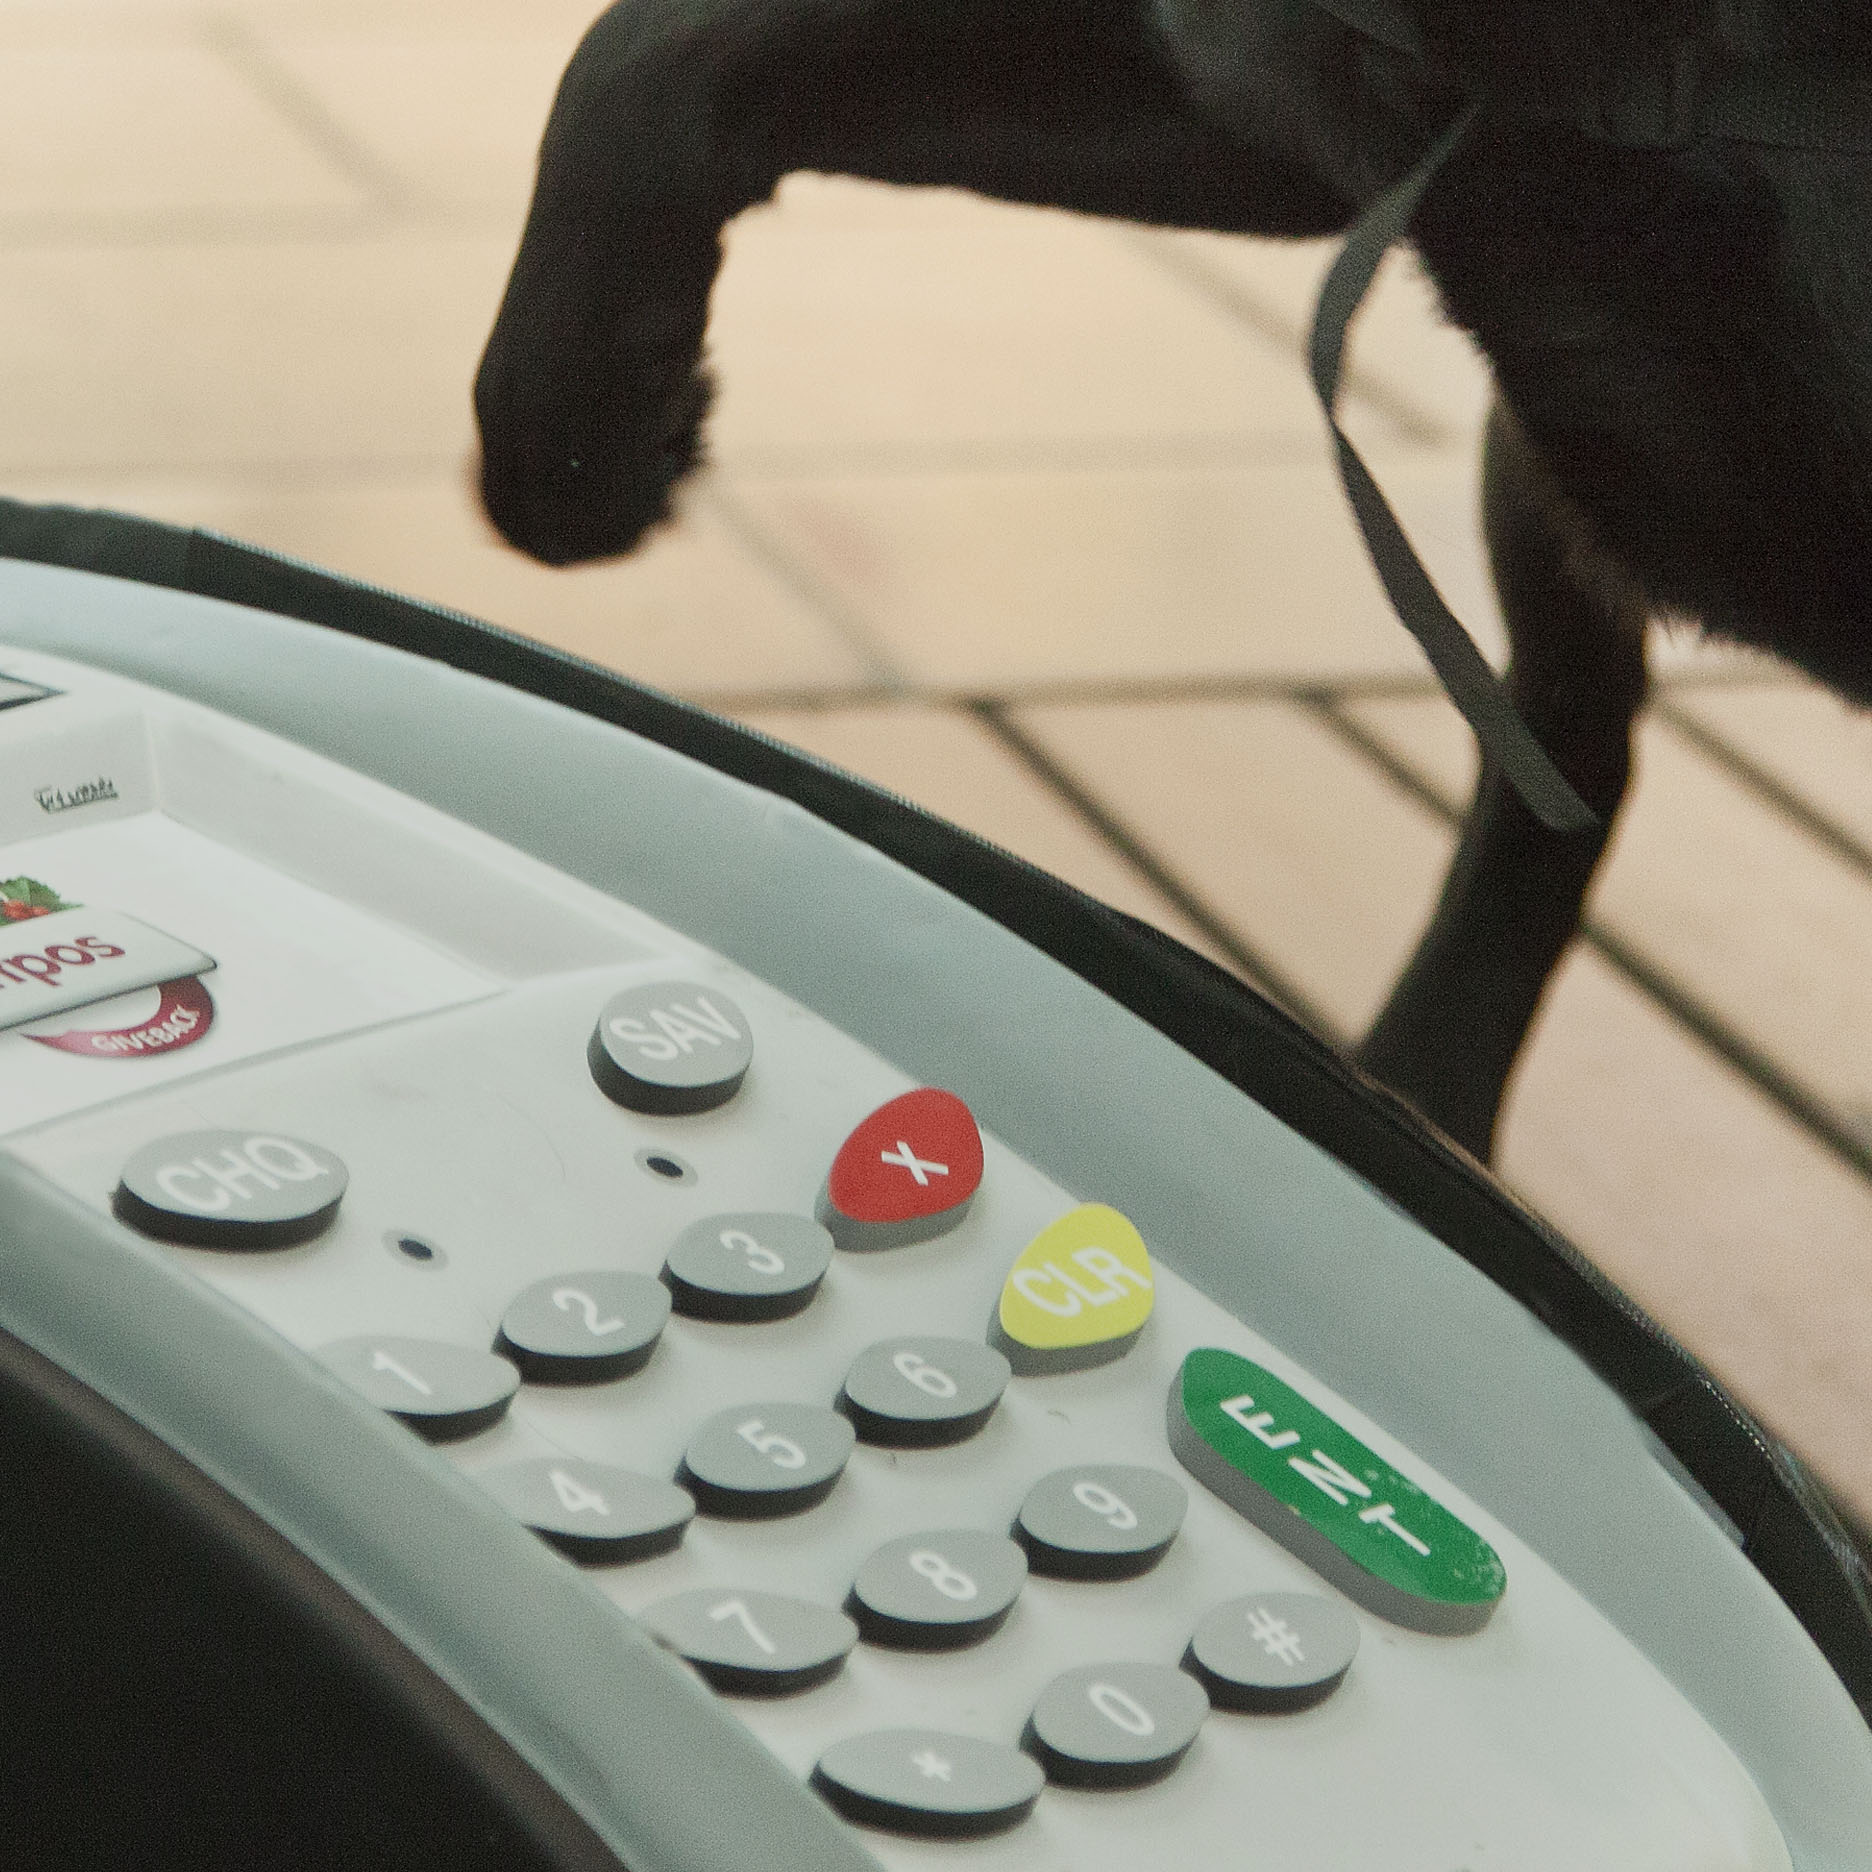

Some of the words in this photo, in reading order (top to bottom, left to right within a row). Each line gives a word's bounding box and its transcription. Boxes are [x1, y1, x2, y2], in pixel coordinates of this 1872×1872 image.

[608, 996, 742, 1061] SAV
[156, 1136, 330, 1211] CHQ
[719, 1229, 786, 1276] 3
[1012, 1246, 1154, 1317] CLR
[553, 1287, 626, 1336] 2
[373, 1350, 432, 1396] 1
[892, 1351, 958, 1400] 6
[736, 1419, 807, 1470] 5
[549, 1469, 611, 1517] 4
[1219, 1394, 1431, 1557] ENT
[1072, 1481, 1139, 1531] 9
[909, 1550, 978, 1602] 8
[708, 1600, 778, 1656] 7
[1088, 1682, 1156, 1737] 0
